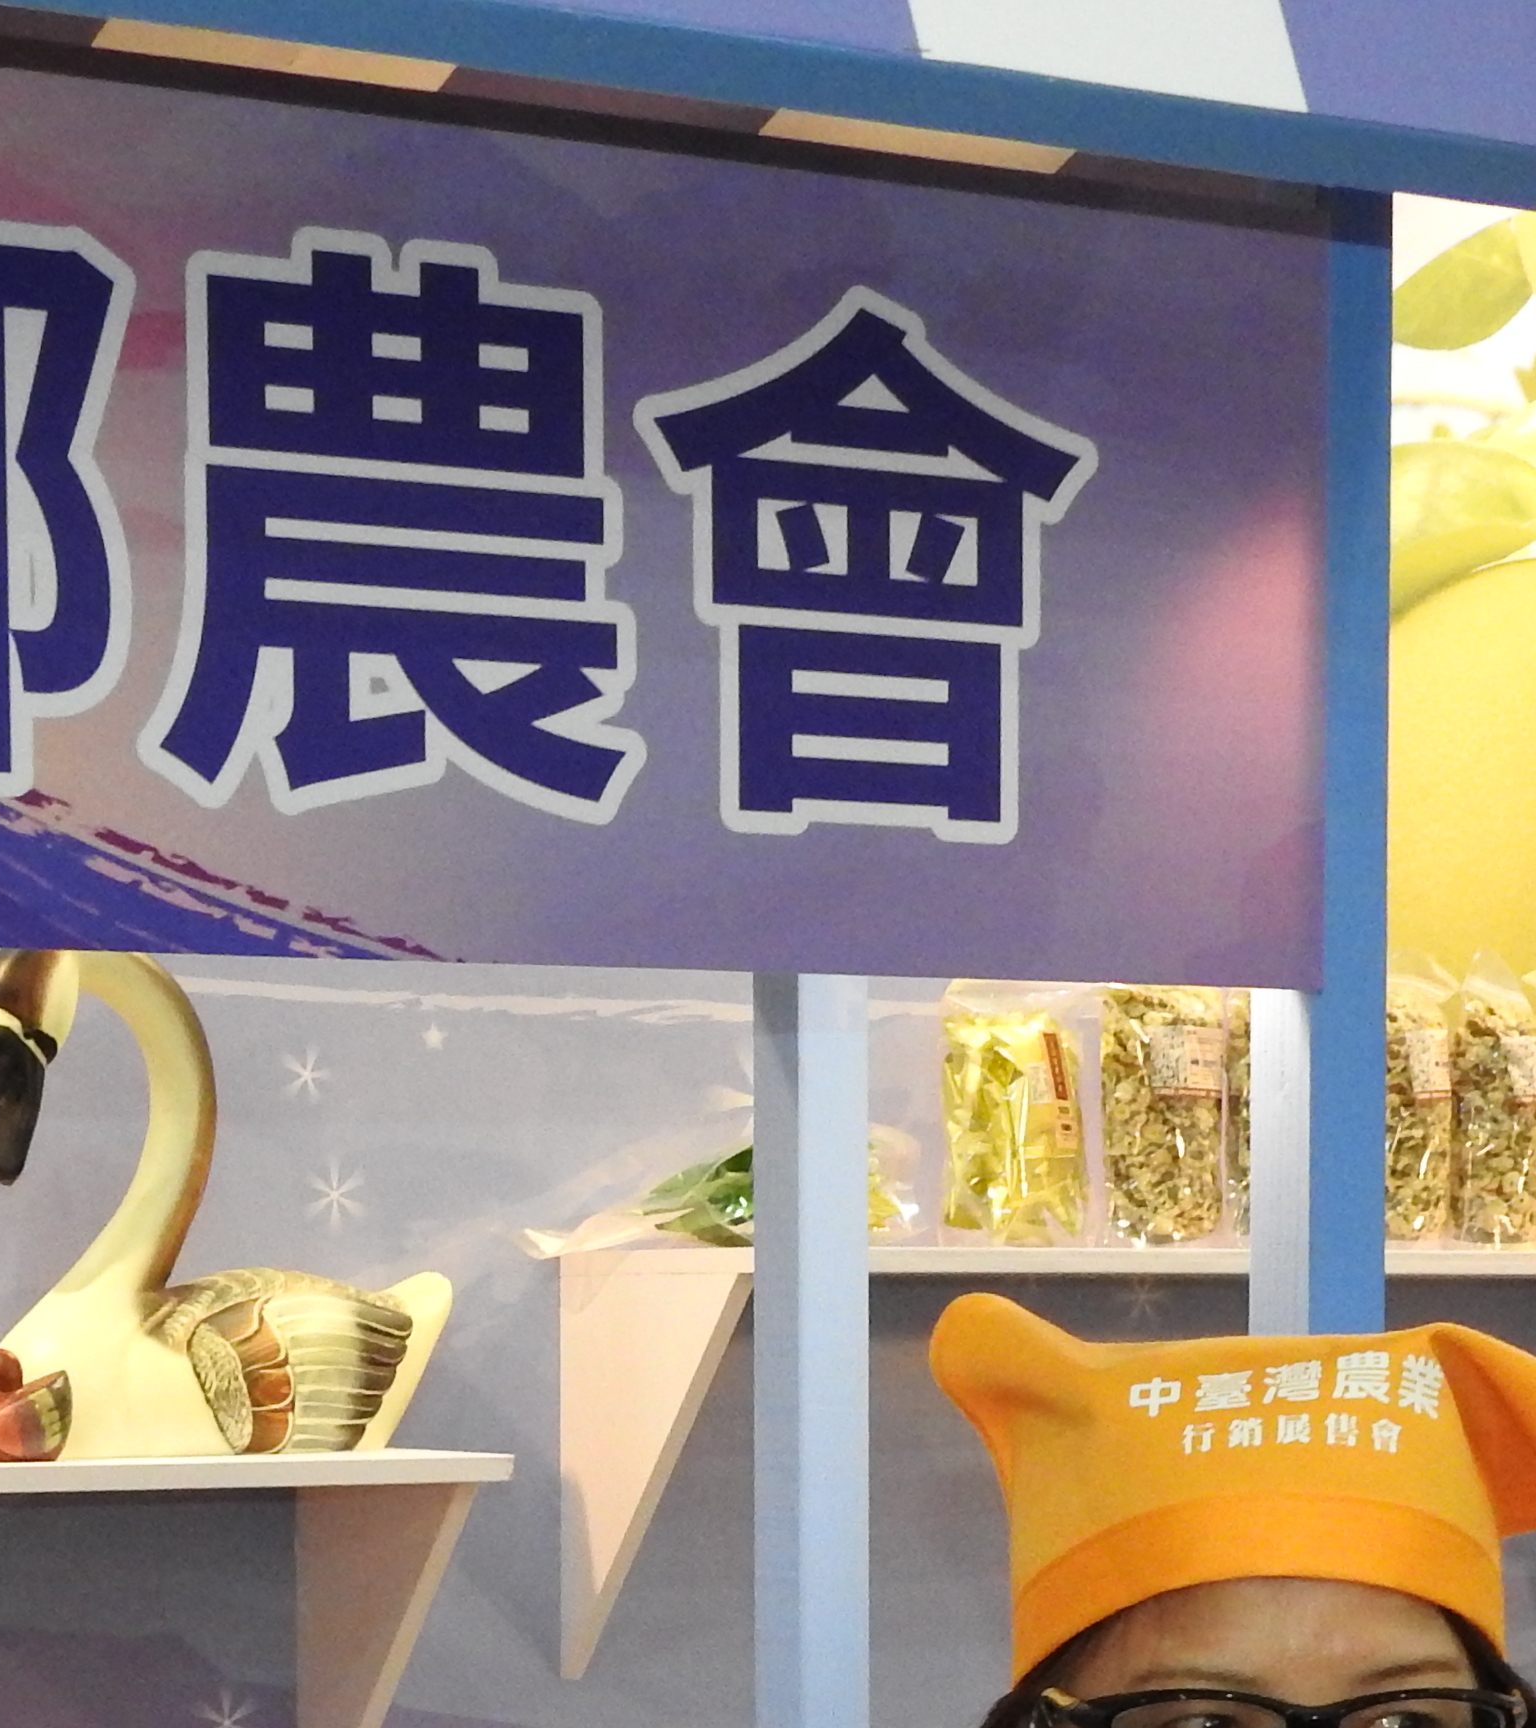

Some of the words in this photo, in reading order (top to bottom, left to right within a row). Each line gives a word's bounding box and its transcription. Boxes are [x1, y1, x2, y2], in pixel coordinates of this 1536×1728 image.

[1128, 1350, 1445, 1420] 中臺灣農業
[1181, 1412, 1403, 1455] 行銷展售會
